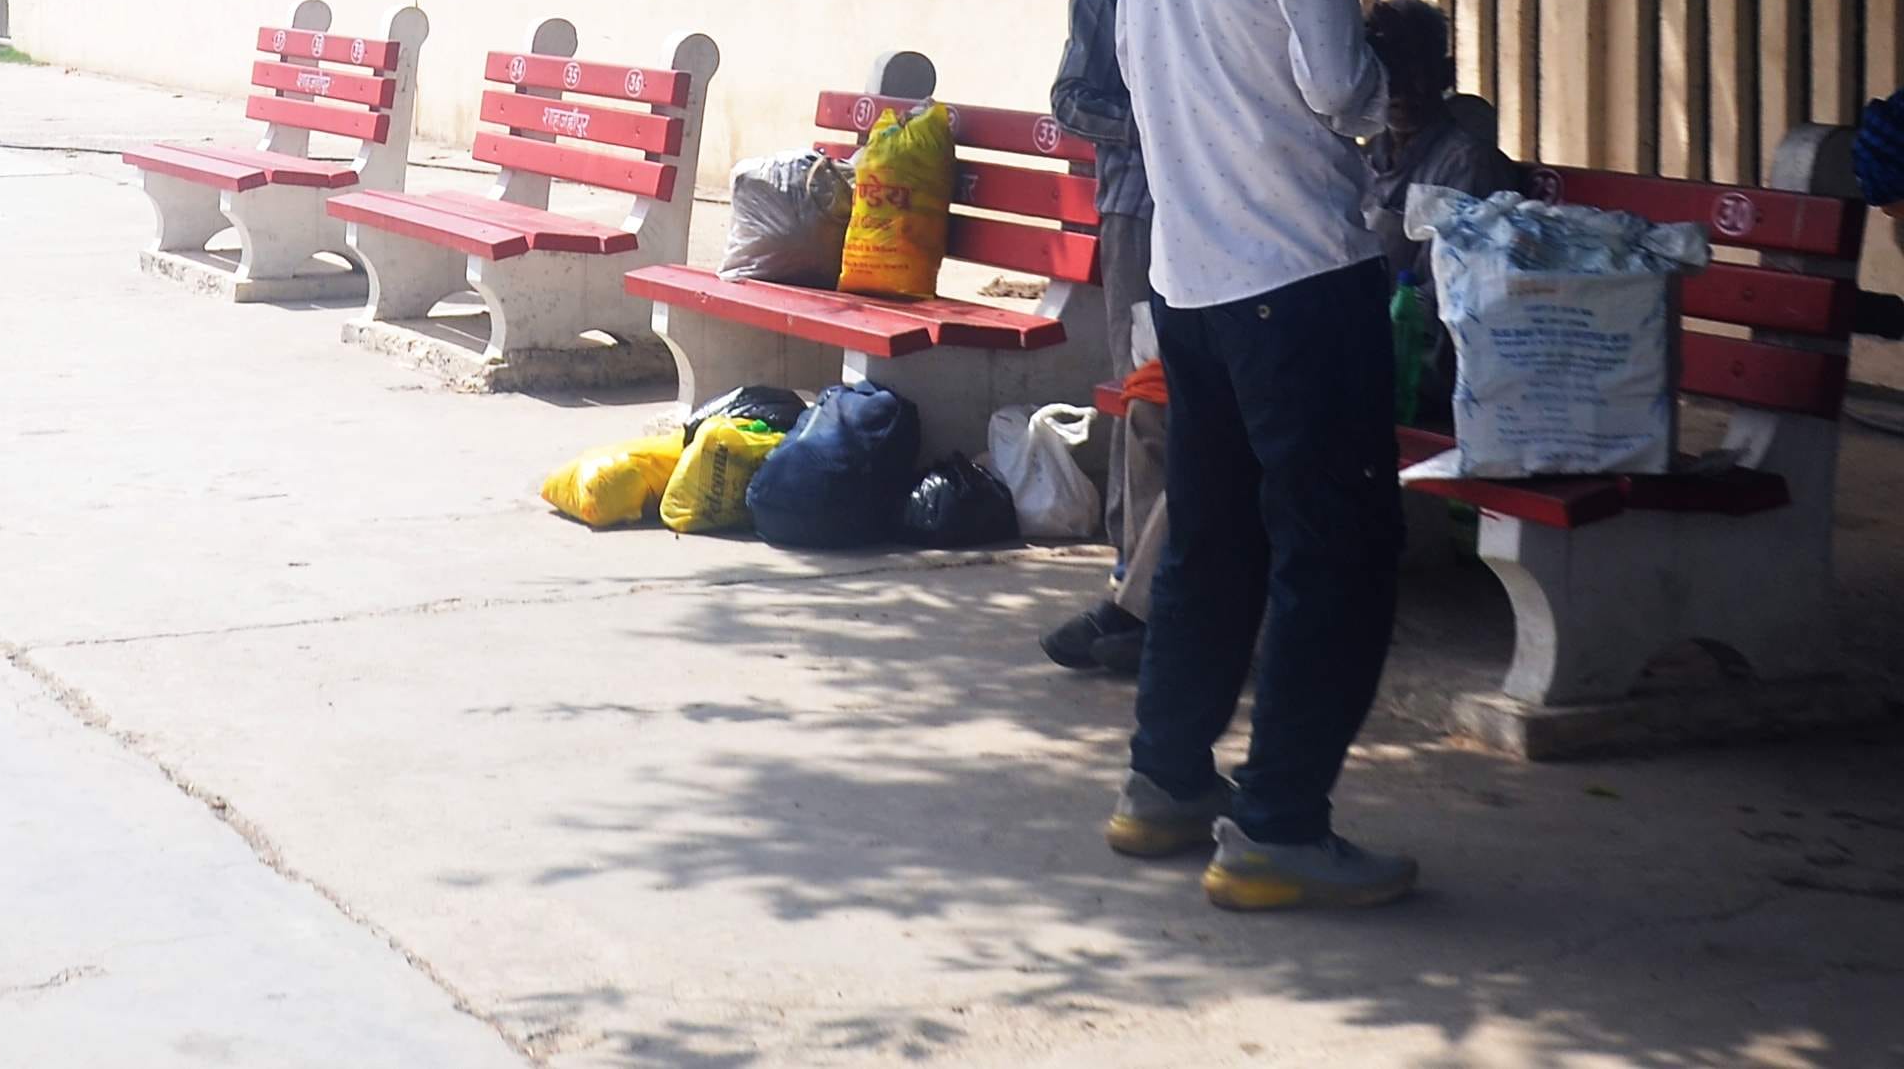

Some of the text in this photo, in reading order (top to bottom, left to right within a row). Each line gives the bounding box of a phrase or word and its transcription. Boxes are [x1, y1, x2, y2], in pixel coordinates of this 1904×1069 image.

[511, 58, 642, 94] 34 35 36
[855, 99, 872, 127] 31
[1036, 119, 1058, 149] 33
[1716, 196, 1752, 232] 30
